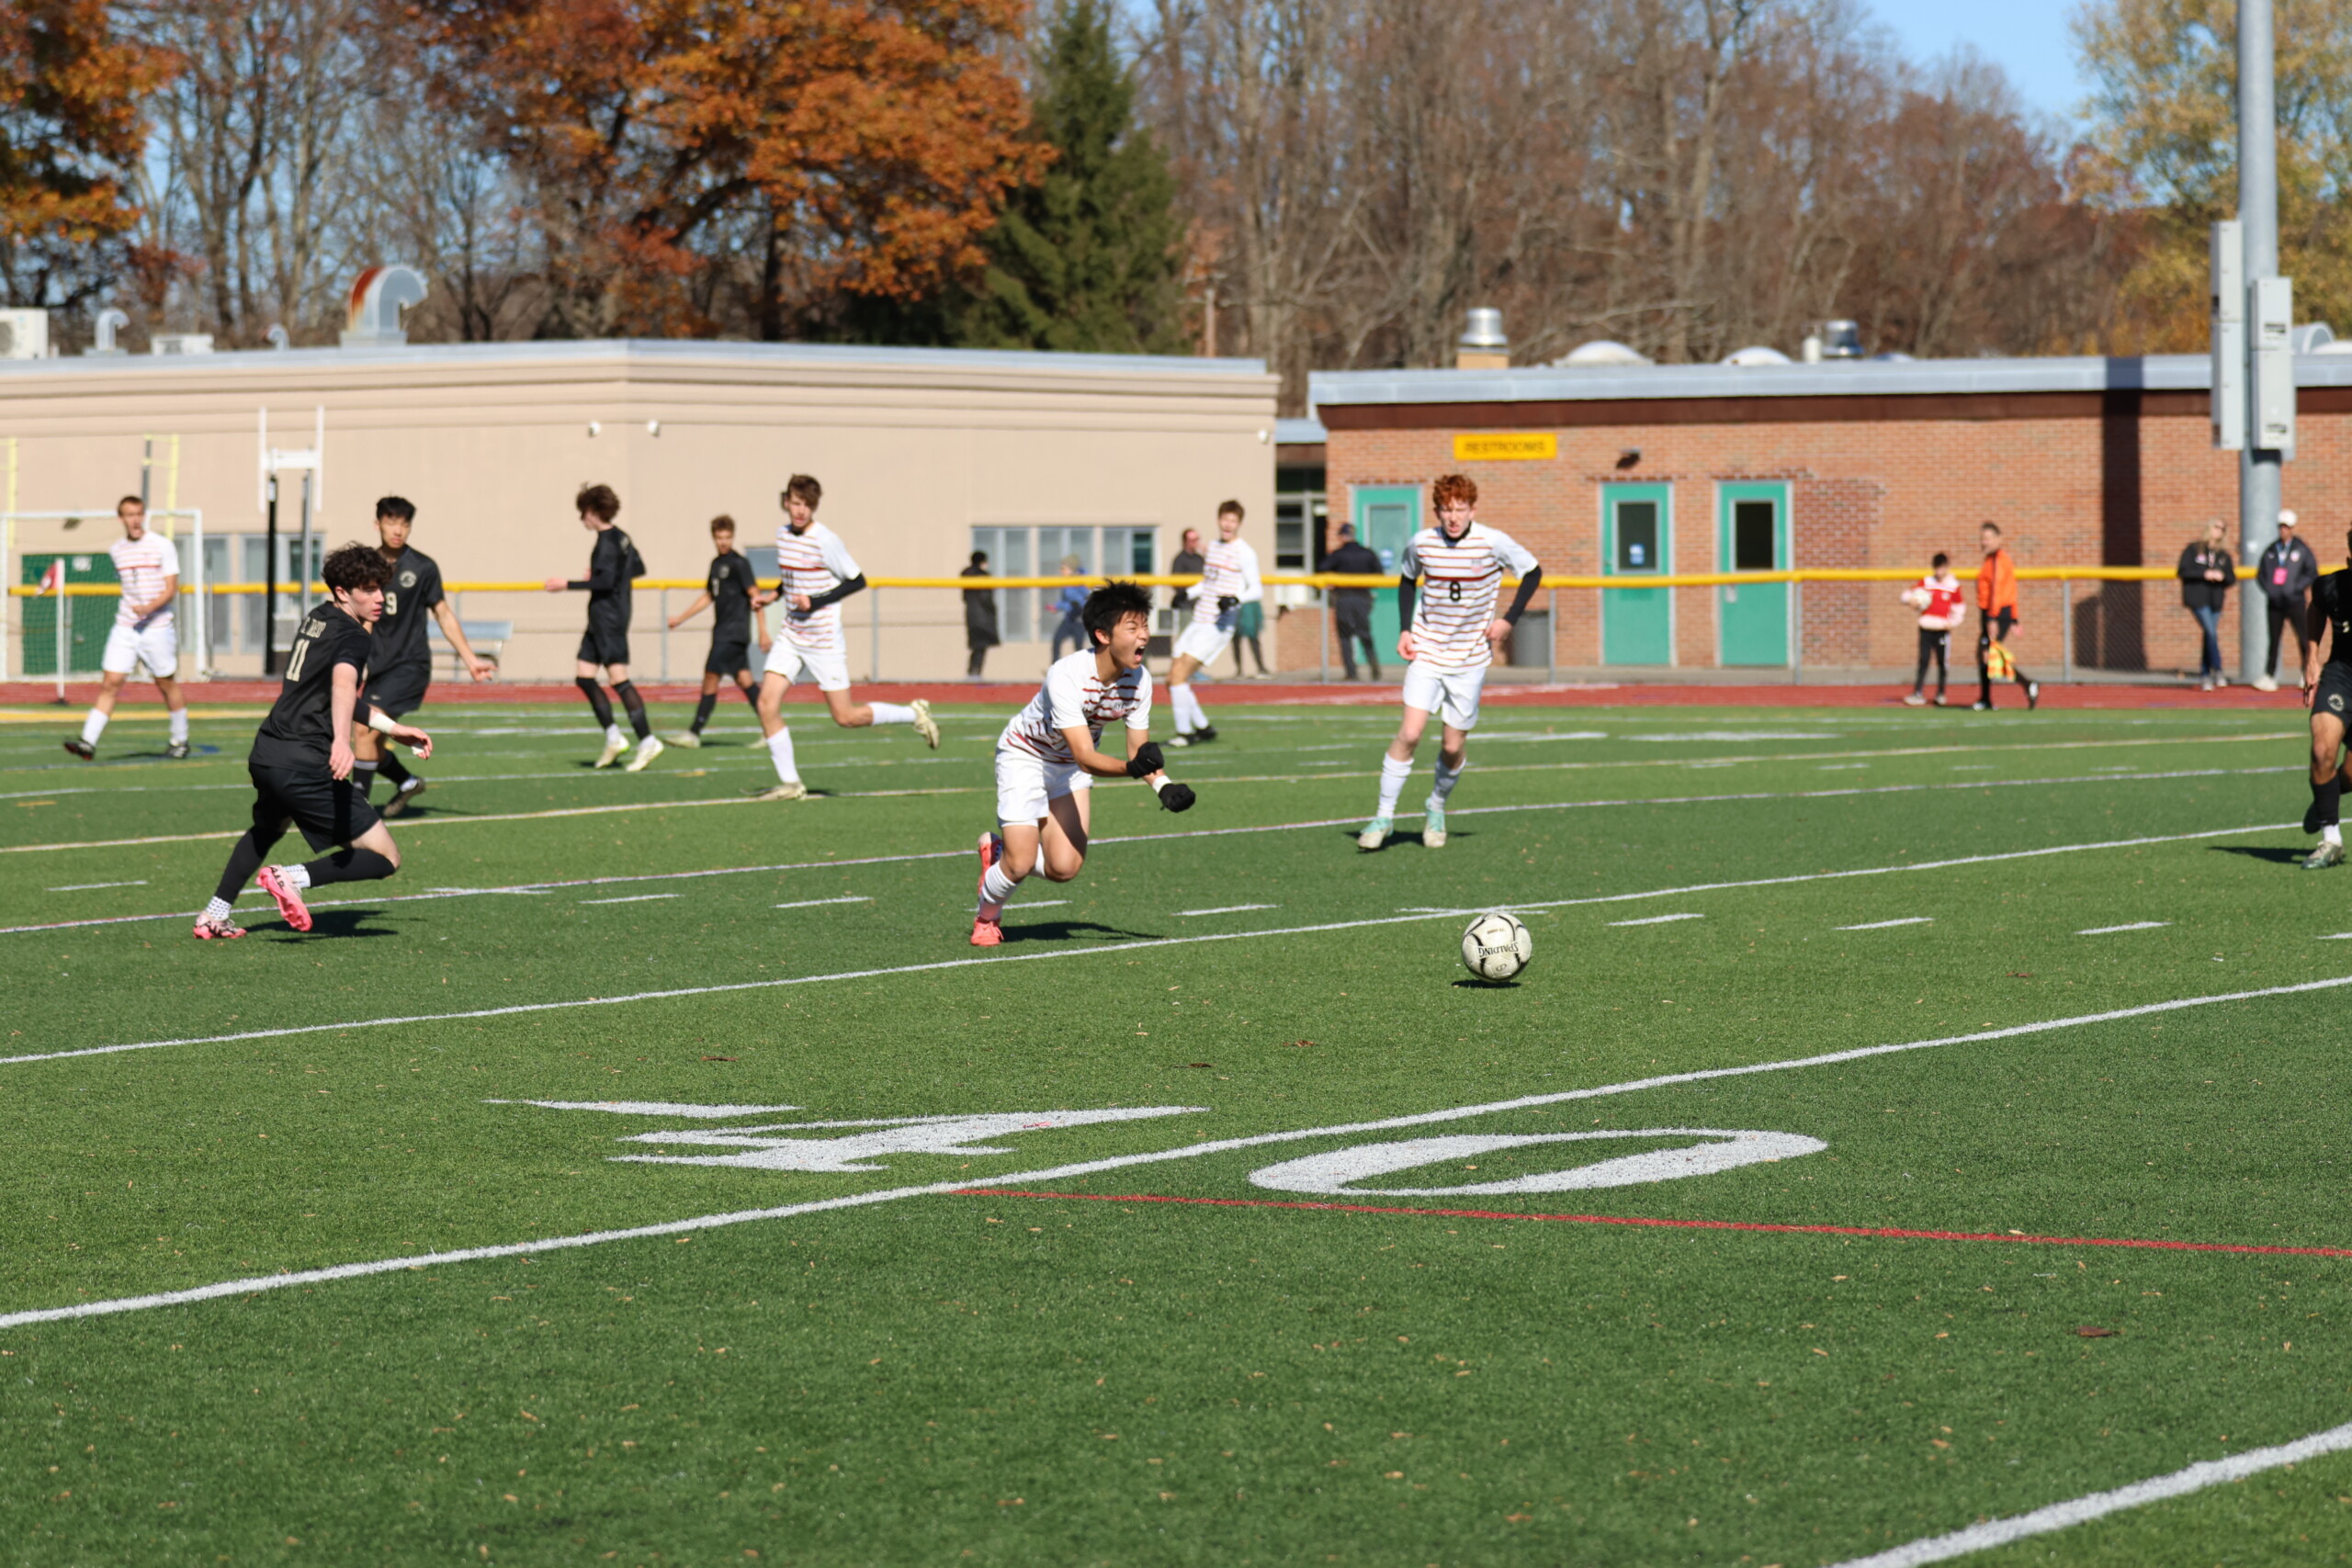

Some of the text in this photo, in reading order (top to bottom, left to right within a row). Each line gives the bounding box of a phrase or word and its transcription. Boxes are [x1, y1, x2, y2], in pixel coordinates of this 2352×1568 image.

[1464, 440, 1545, 454] RESTROOMS
[385, 591, 398, 615] 9
[1449, 581, 1462, 603] 8
[286, 637, 311, 682] 11
[1477, 942, 1520, 958] SPALDING
